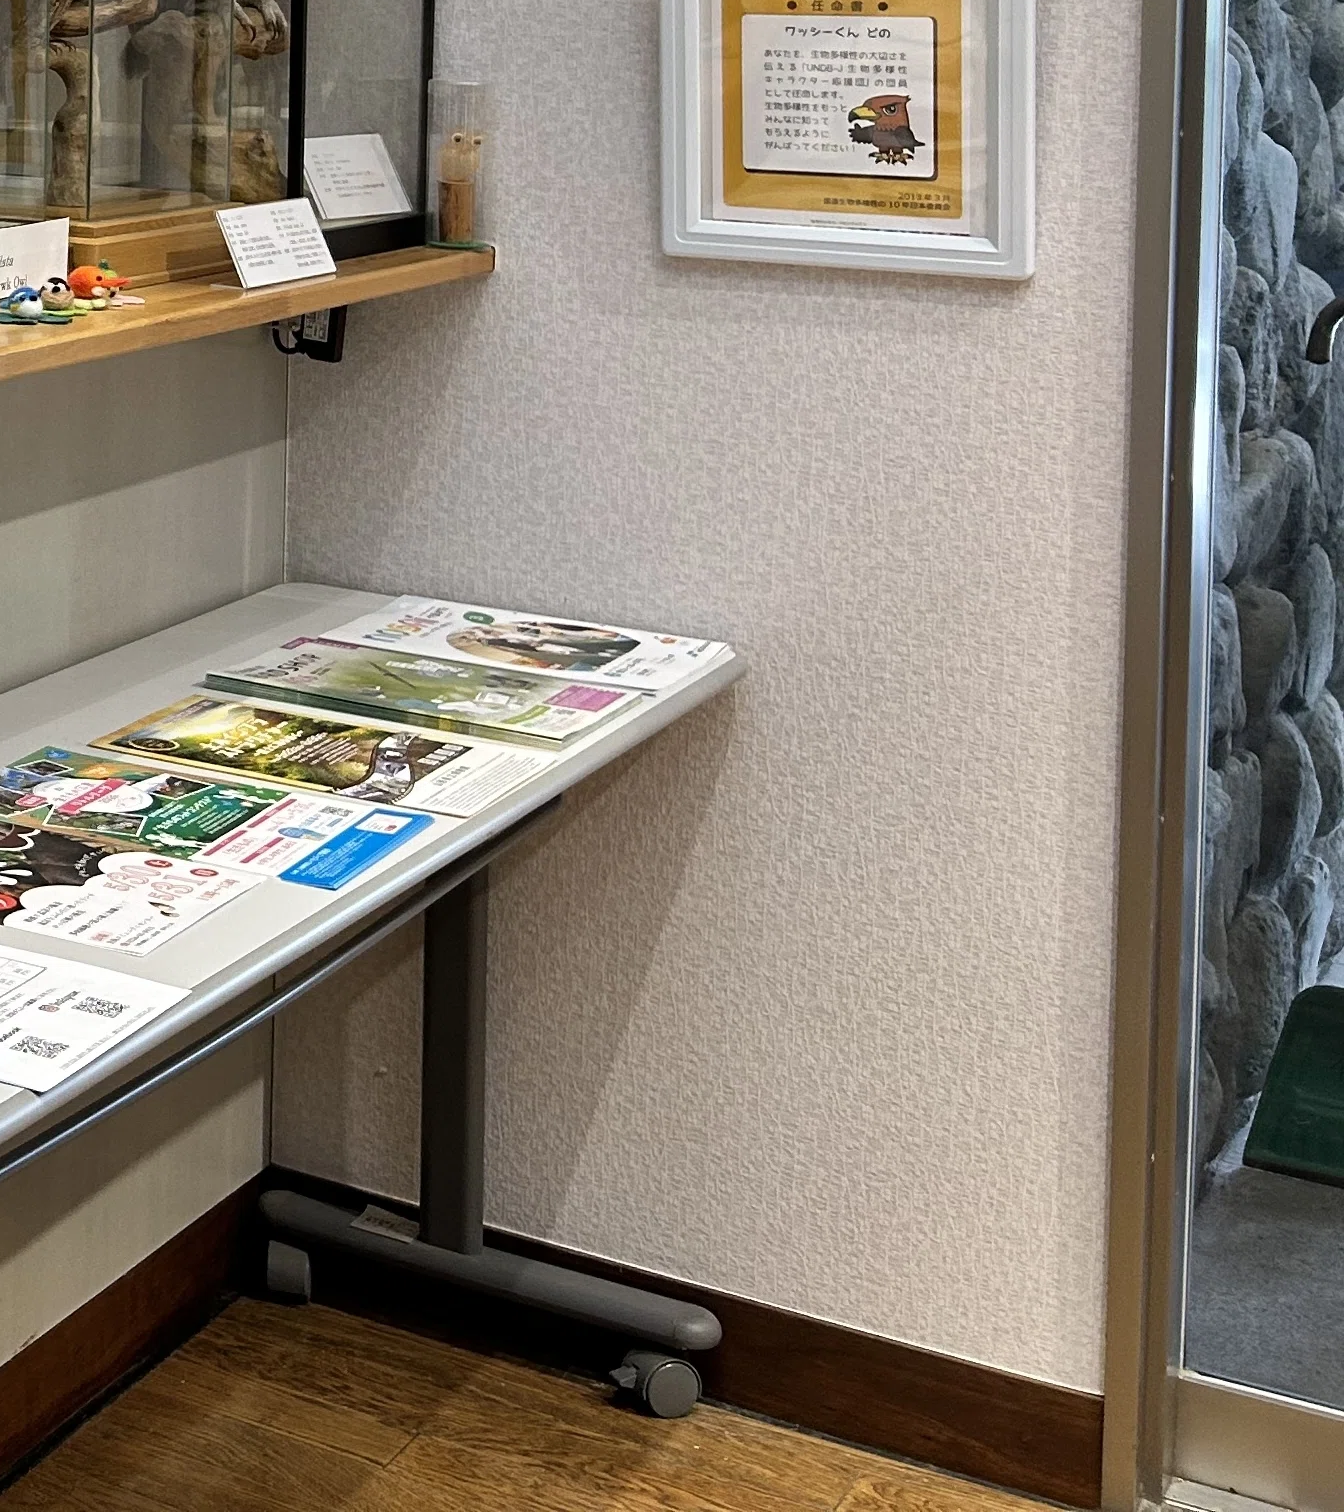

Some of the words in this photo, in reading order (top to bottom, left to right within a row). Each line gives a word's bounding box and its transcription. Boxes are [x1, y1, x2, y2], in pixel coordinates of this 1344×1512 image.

[811, 0, 864, 13] 任命書
[784, 25, 859, 39] ワッシーくん
[866, 27, 891, 39] どの
[764, 115, 829, 126] みんなに知って
[764, 128, 829, 139] もらえるように
[13, 274, 27, 289] Owl
